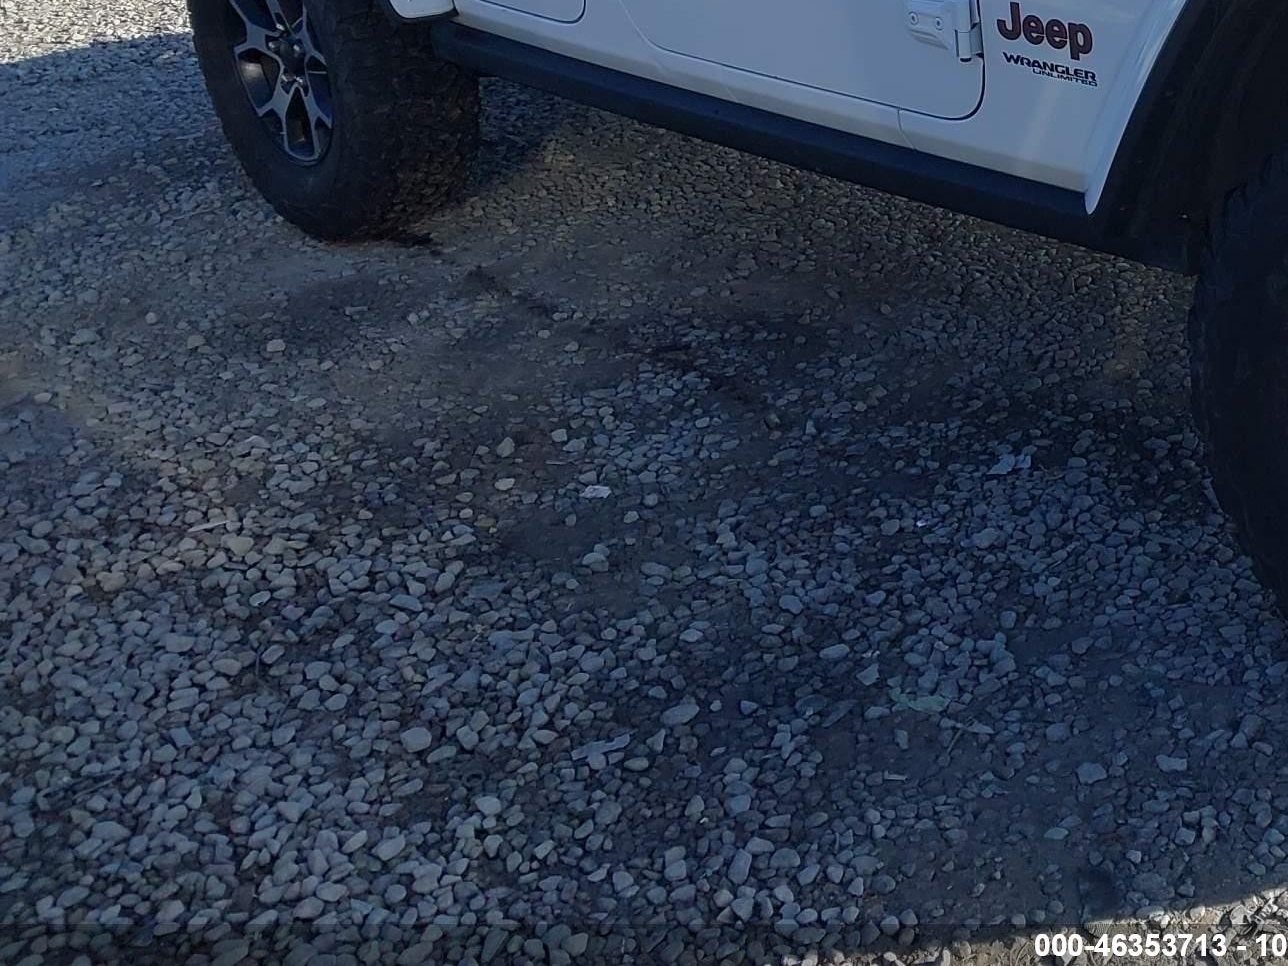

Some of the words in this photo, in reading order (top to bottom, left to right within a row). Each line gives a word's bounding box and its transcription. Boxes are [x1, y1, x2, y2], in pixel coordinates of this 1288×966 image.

[997, 1, 1093, 61] Jeep
[1002, 51, 1097, 82] WRANGLER
[1032, 68, 1098, 87] UNLIMITED
